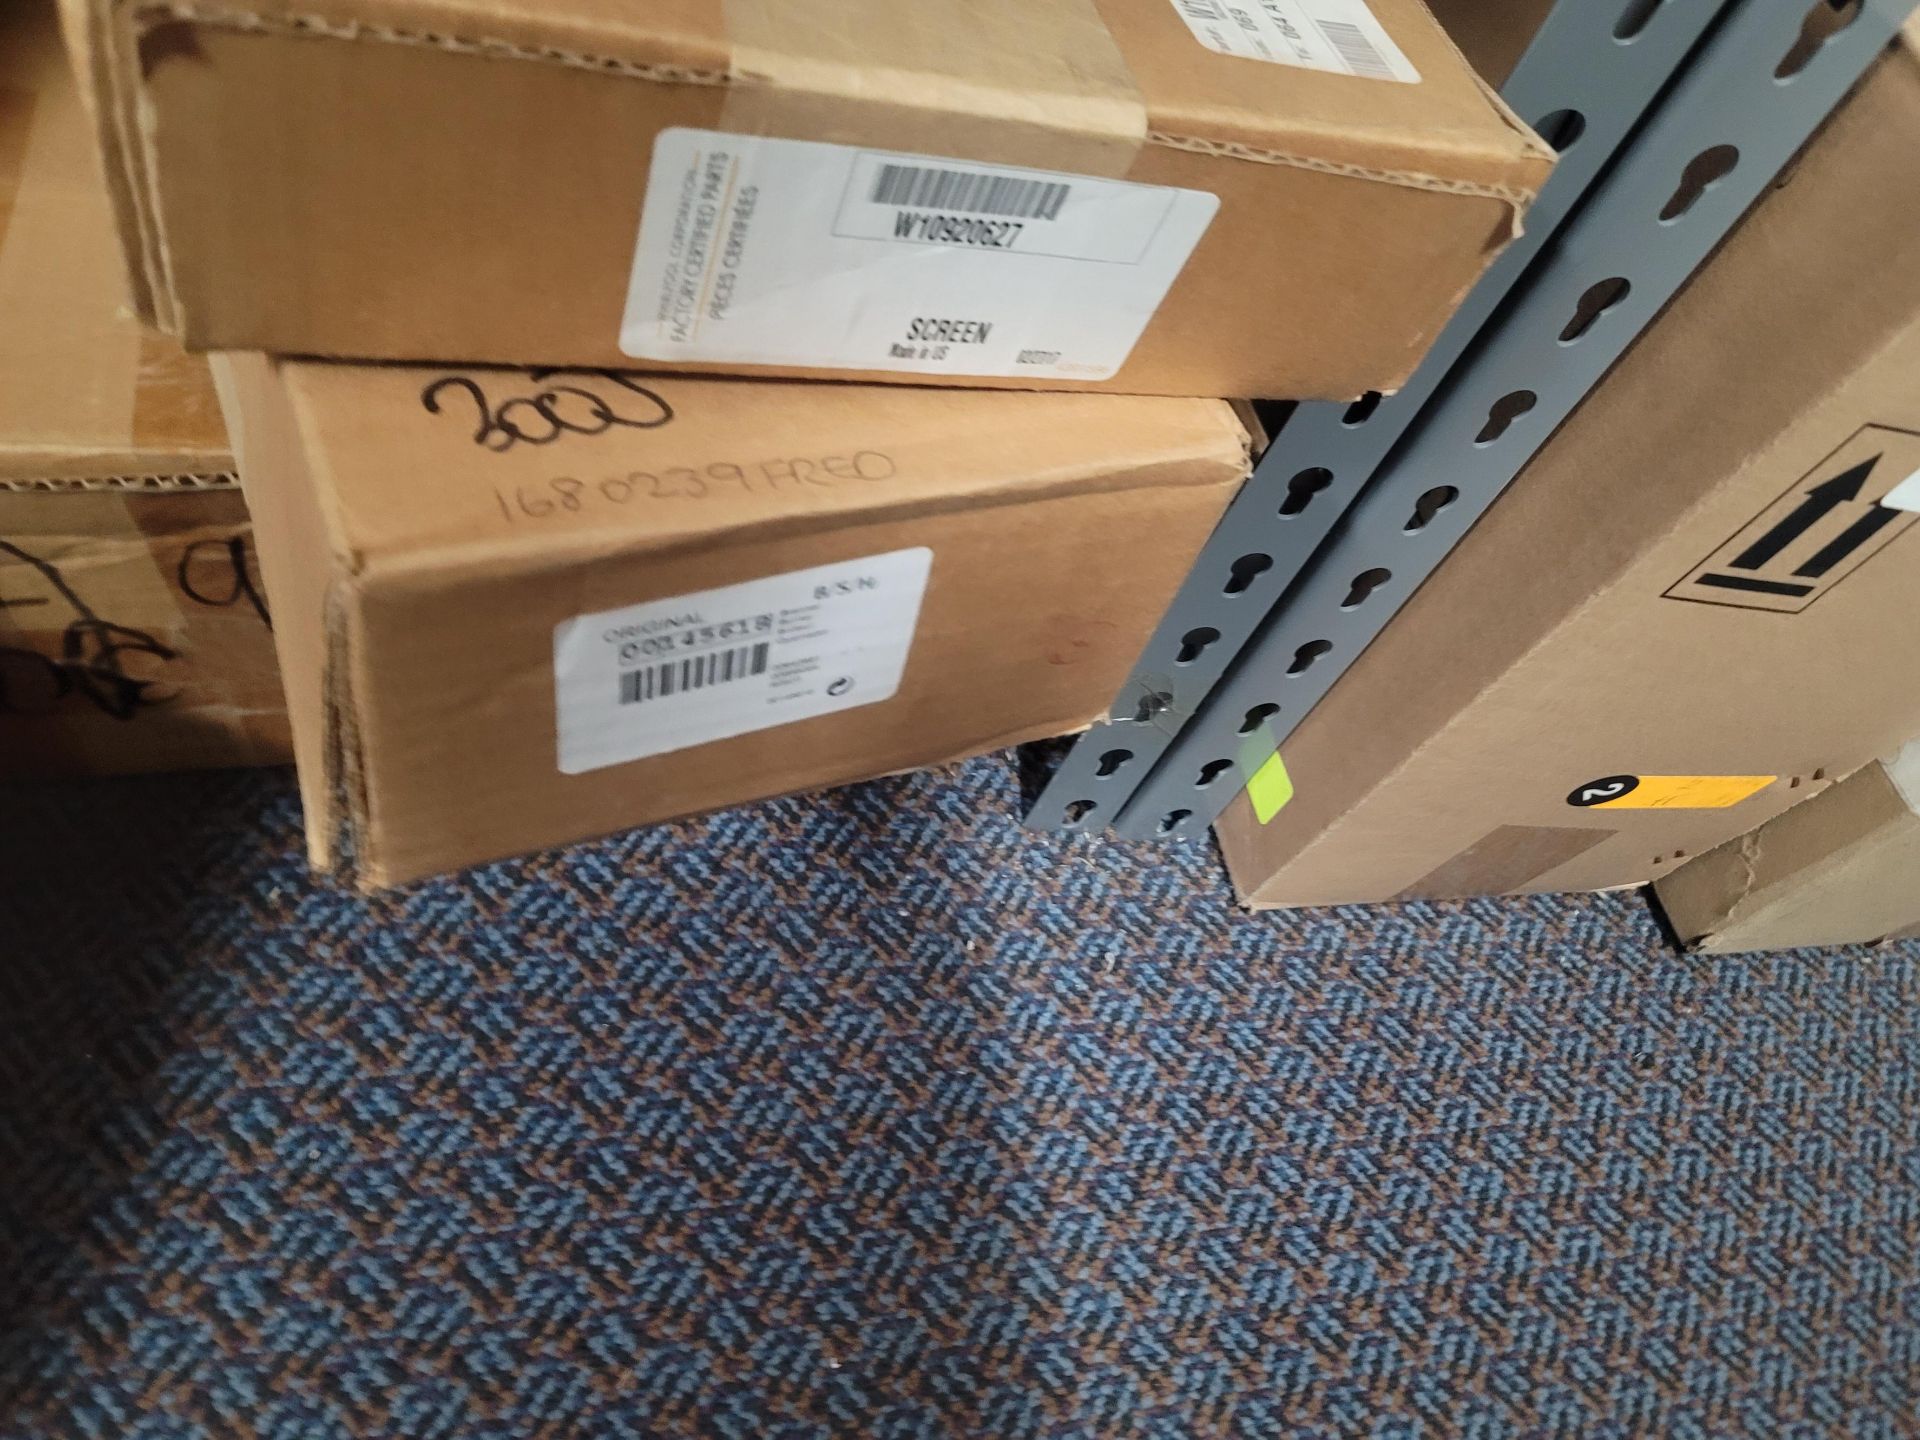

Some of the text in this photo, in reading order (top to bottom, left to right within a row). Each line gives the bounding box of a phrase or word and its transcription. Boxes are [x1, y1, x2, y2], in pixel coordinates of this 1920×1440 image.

[894, 210, 1024, 248] W10920627
[669, 151, 730, 343] FACTORY CERTIFIED PARTS
[907, 317, 994, 344] SCREEN
[601, 612, 704, 645] ORIGINAL
[1582, 782, 1625, 802] 2
